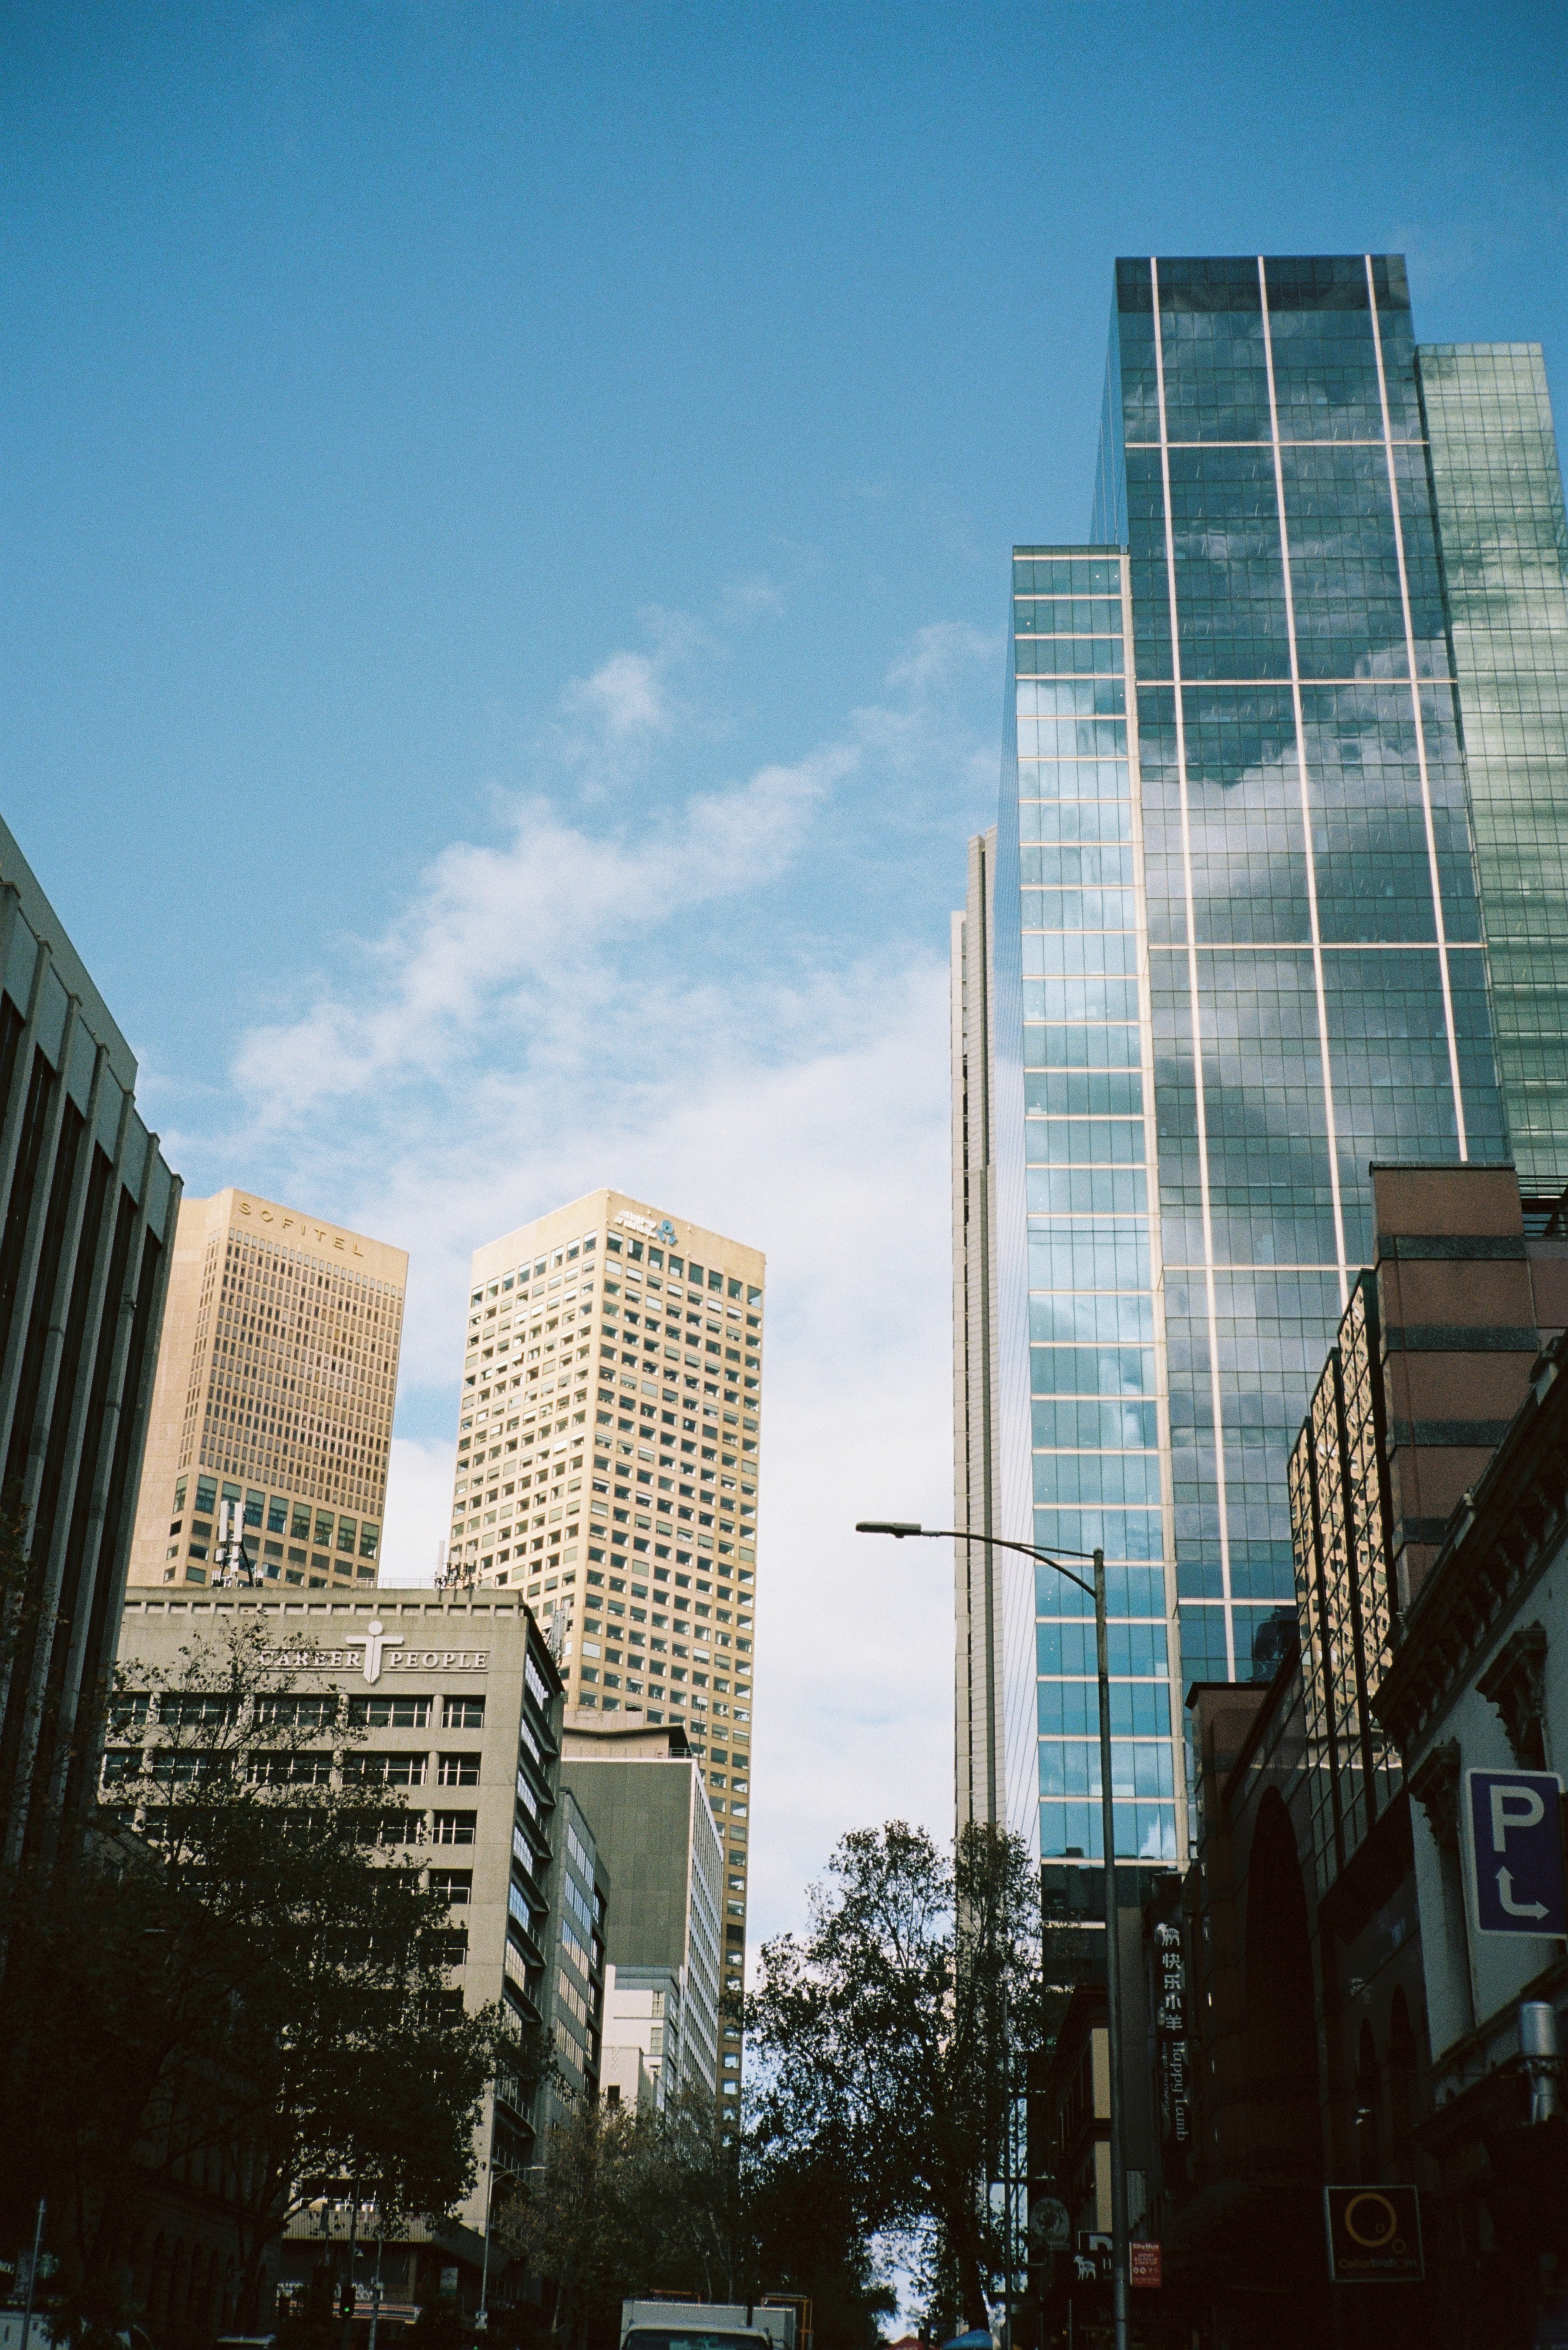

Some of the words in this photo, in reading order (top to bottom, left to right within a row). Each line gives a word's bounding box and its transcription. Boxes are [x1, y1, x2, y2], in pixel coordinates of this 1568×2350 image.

[239, 1202, 364, 1258] SOFITEL
[614, 1210, 656, 1238] ANZ
[259, 1651, 360, 1667] CAREER
[390, 1652, 487, 1668] PEOPLE
[1490, 1784, 1545, 1852] P
[1162, 1952, 1183, 2030] 快乐小羊
[1170, 2042, 1185, 2092] Happy
[1175, 2099, 1189, 2141] Lamb
